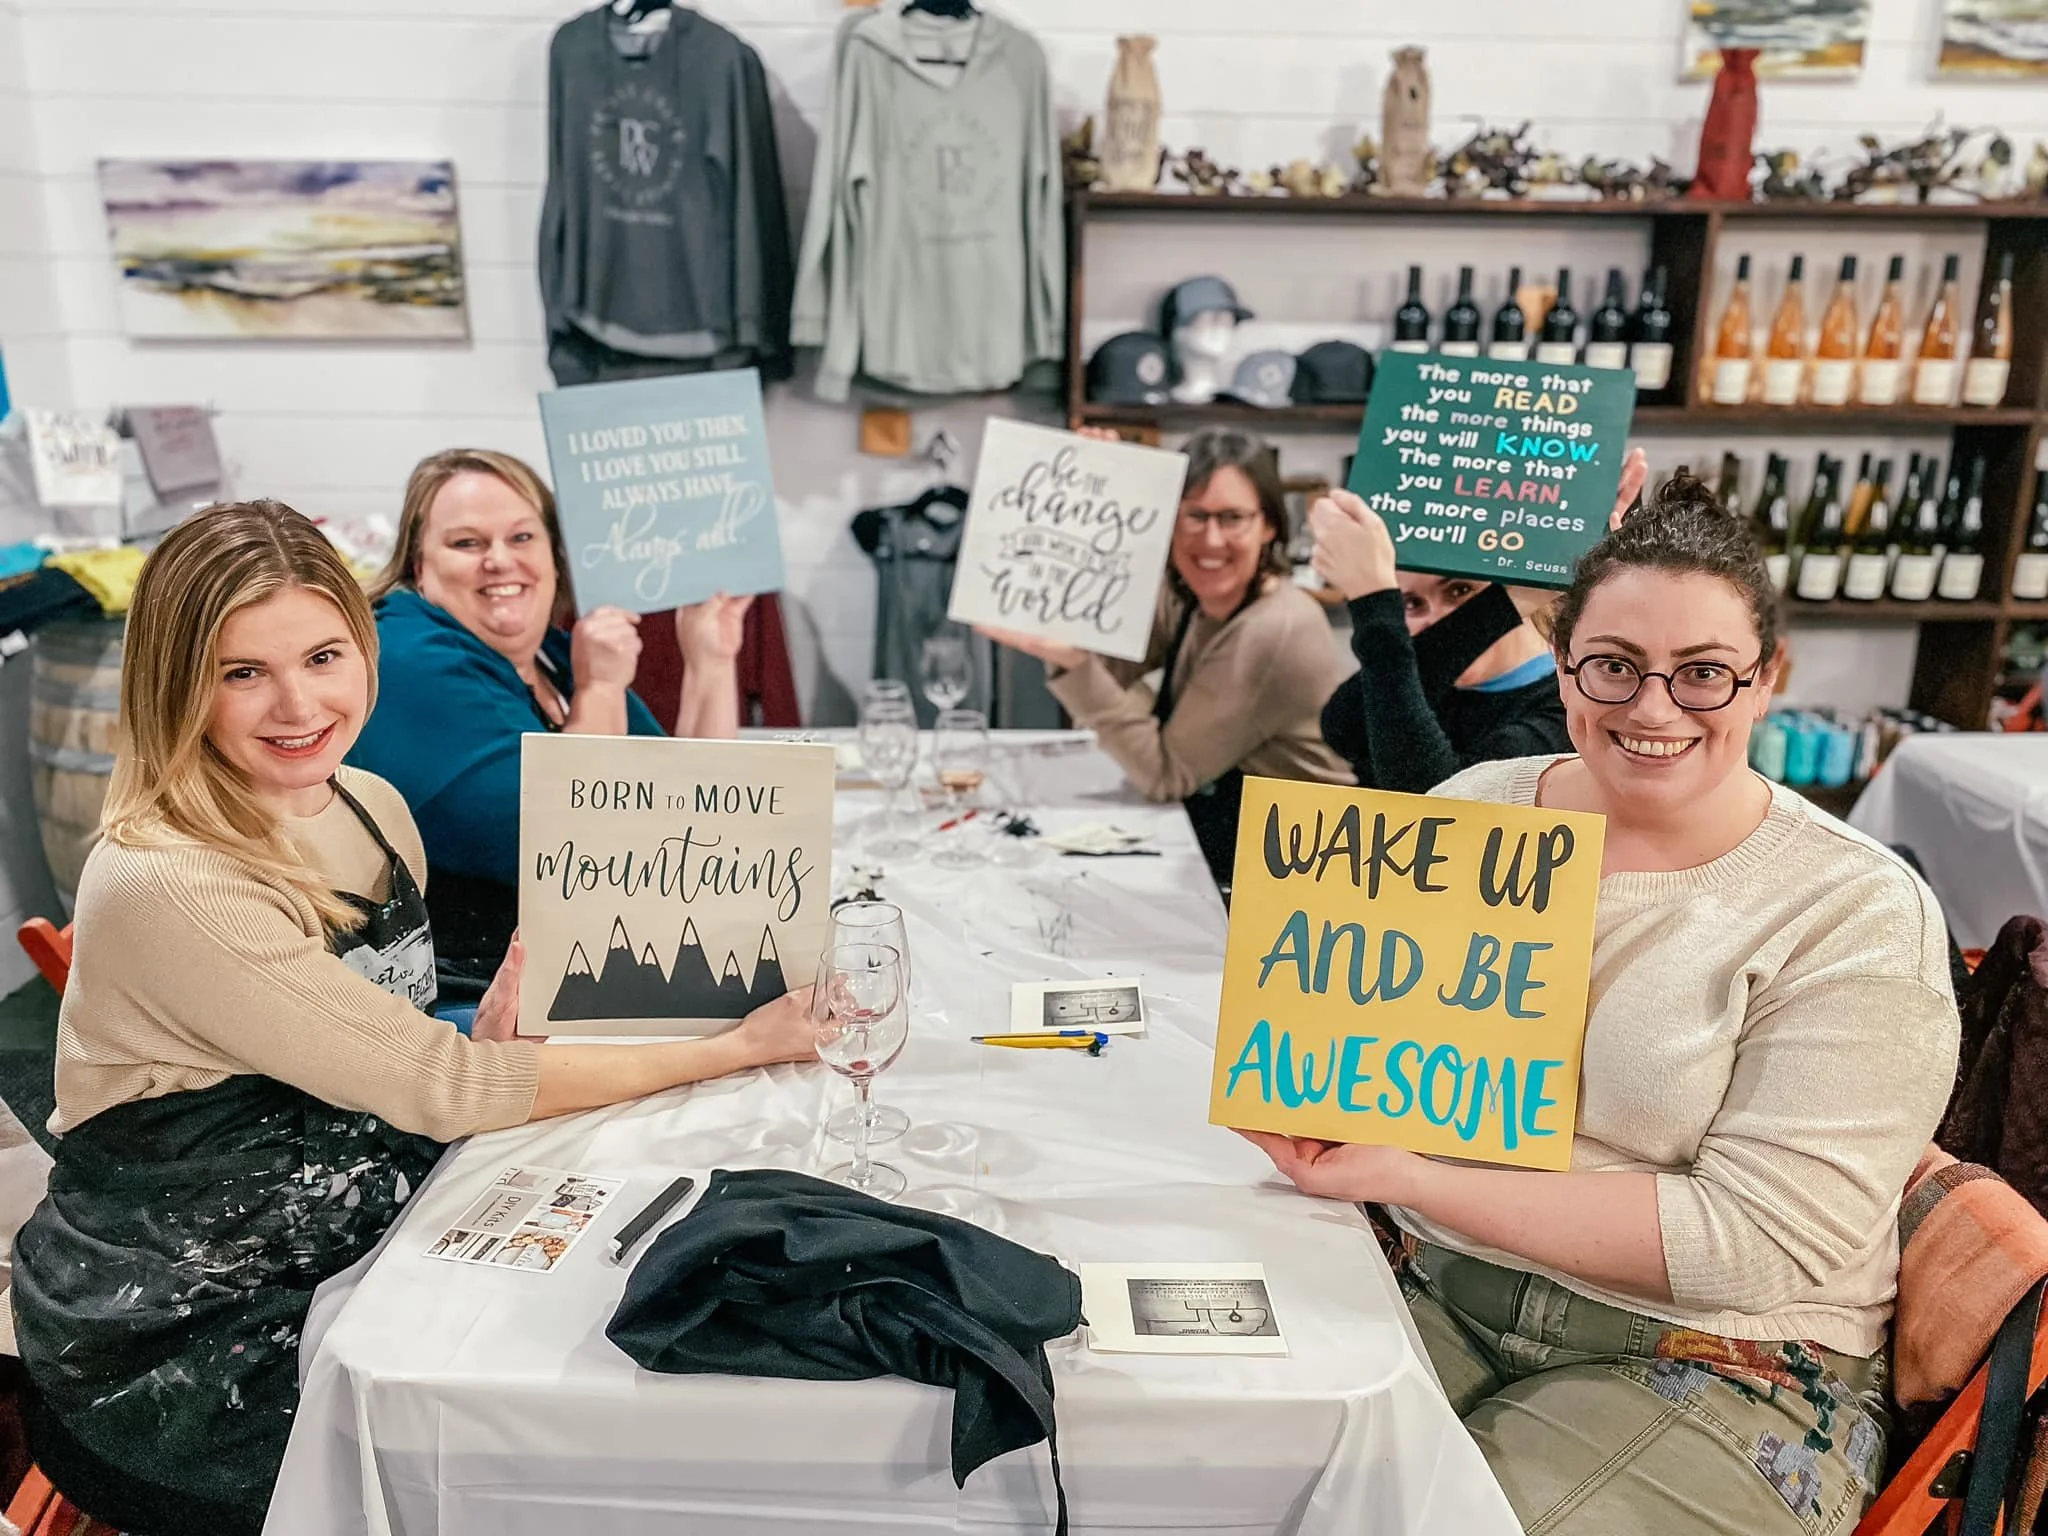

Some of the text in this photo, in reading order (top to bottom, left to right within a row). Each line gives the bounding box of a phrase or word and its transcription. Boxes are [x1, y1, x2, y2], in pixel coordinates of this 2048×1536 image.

[1418, 364, 1593, 393] The more that
[1427, 387, 1578, 415] you READ
[568, 433, 577, 455] I
[581, 425, 647, 453] LOVED
[651, 419, 692, 445] YOU
[1400, 404, 1593, 438] the more things
[1382, 427, 1600, 466] you will KNOW.
[1398, 448, 1577, 480] The more that
[581, 462, 590, 482] I
[594, 454, 646, 481] LOVE
[648, 449, 692, 474] YOU
[1051, 446, 1082, 488] be
[602, 479, 682, 510] ALWAYS
[989, 461, 1159, 555] change
[1397, 473, 1568, 510] you LEARN,
[1370, 493, 1585, 532] the more places
[1396, 523, 1524, 550] you'll GO
[1497, 557, 1517, 568] Dr.
[1526, 560, 1568, 574] Seuss
[980, 563, 1131, 634] world
[571, 779, 785, 815] BORN TO MOVE
[536, 826, 814, 922] mountains
[1263, 802, 1575, 914] WAKE UP
[1258, 910, 1554, 1018] AND BE
[1226, 1019, 1565, 1151] AWESOME
[484, 1211, 508, 1227] Kits
[501, 1197, 521, 1210] DIY
